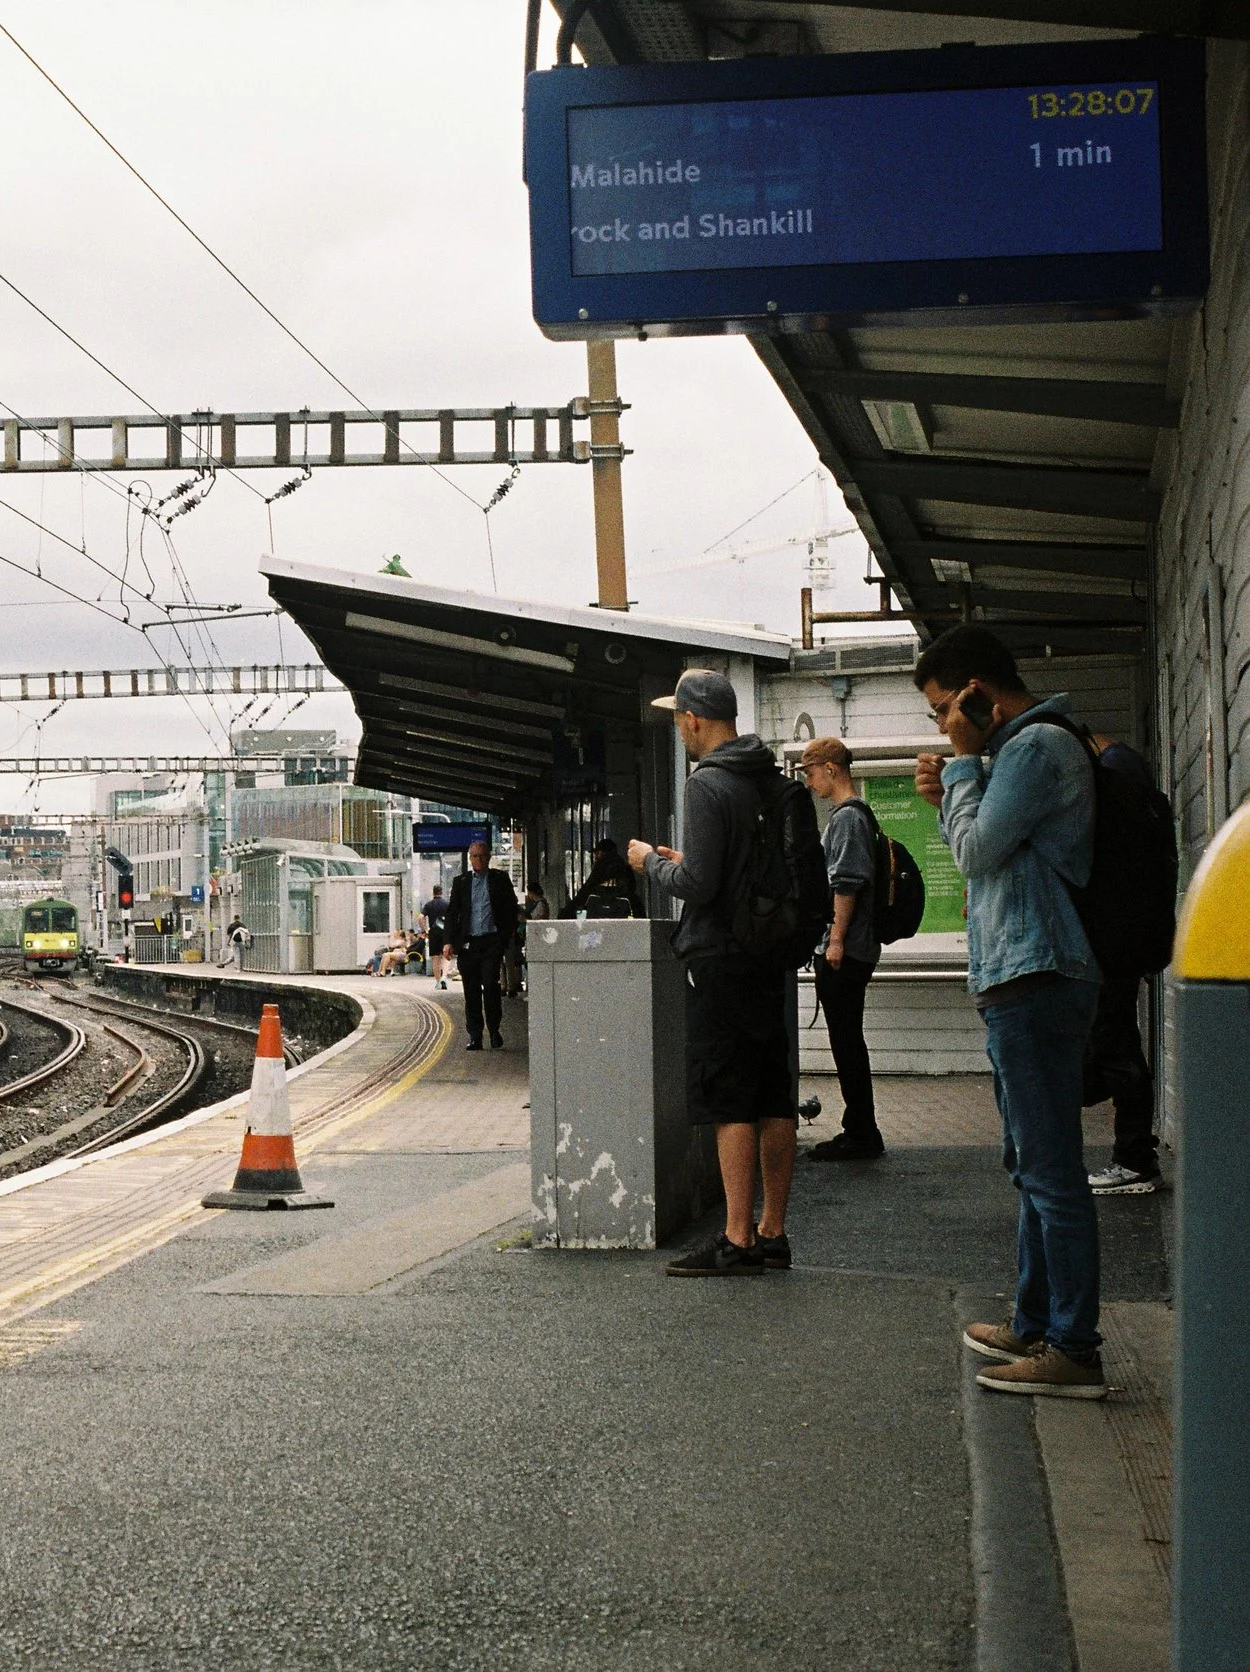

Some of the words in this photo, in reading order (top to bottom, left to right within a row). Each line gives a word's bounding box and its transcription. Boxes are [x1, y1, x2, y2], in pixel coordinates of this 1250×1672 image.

[1027, 88, 1154, 119] 13:28:07
[1029, 142, 1041, 168] 1
[1057, 140, 1111, 167] min
[571, 160, 701, 188] Malahide
[638, 215, 689, 240] and
[699, 209, 813, 238] Shankill
[870, 801, 911, 810] Customer
